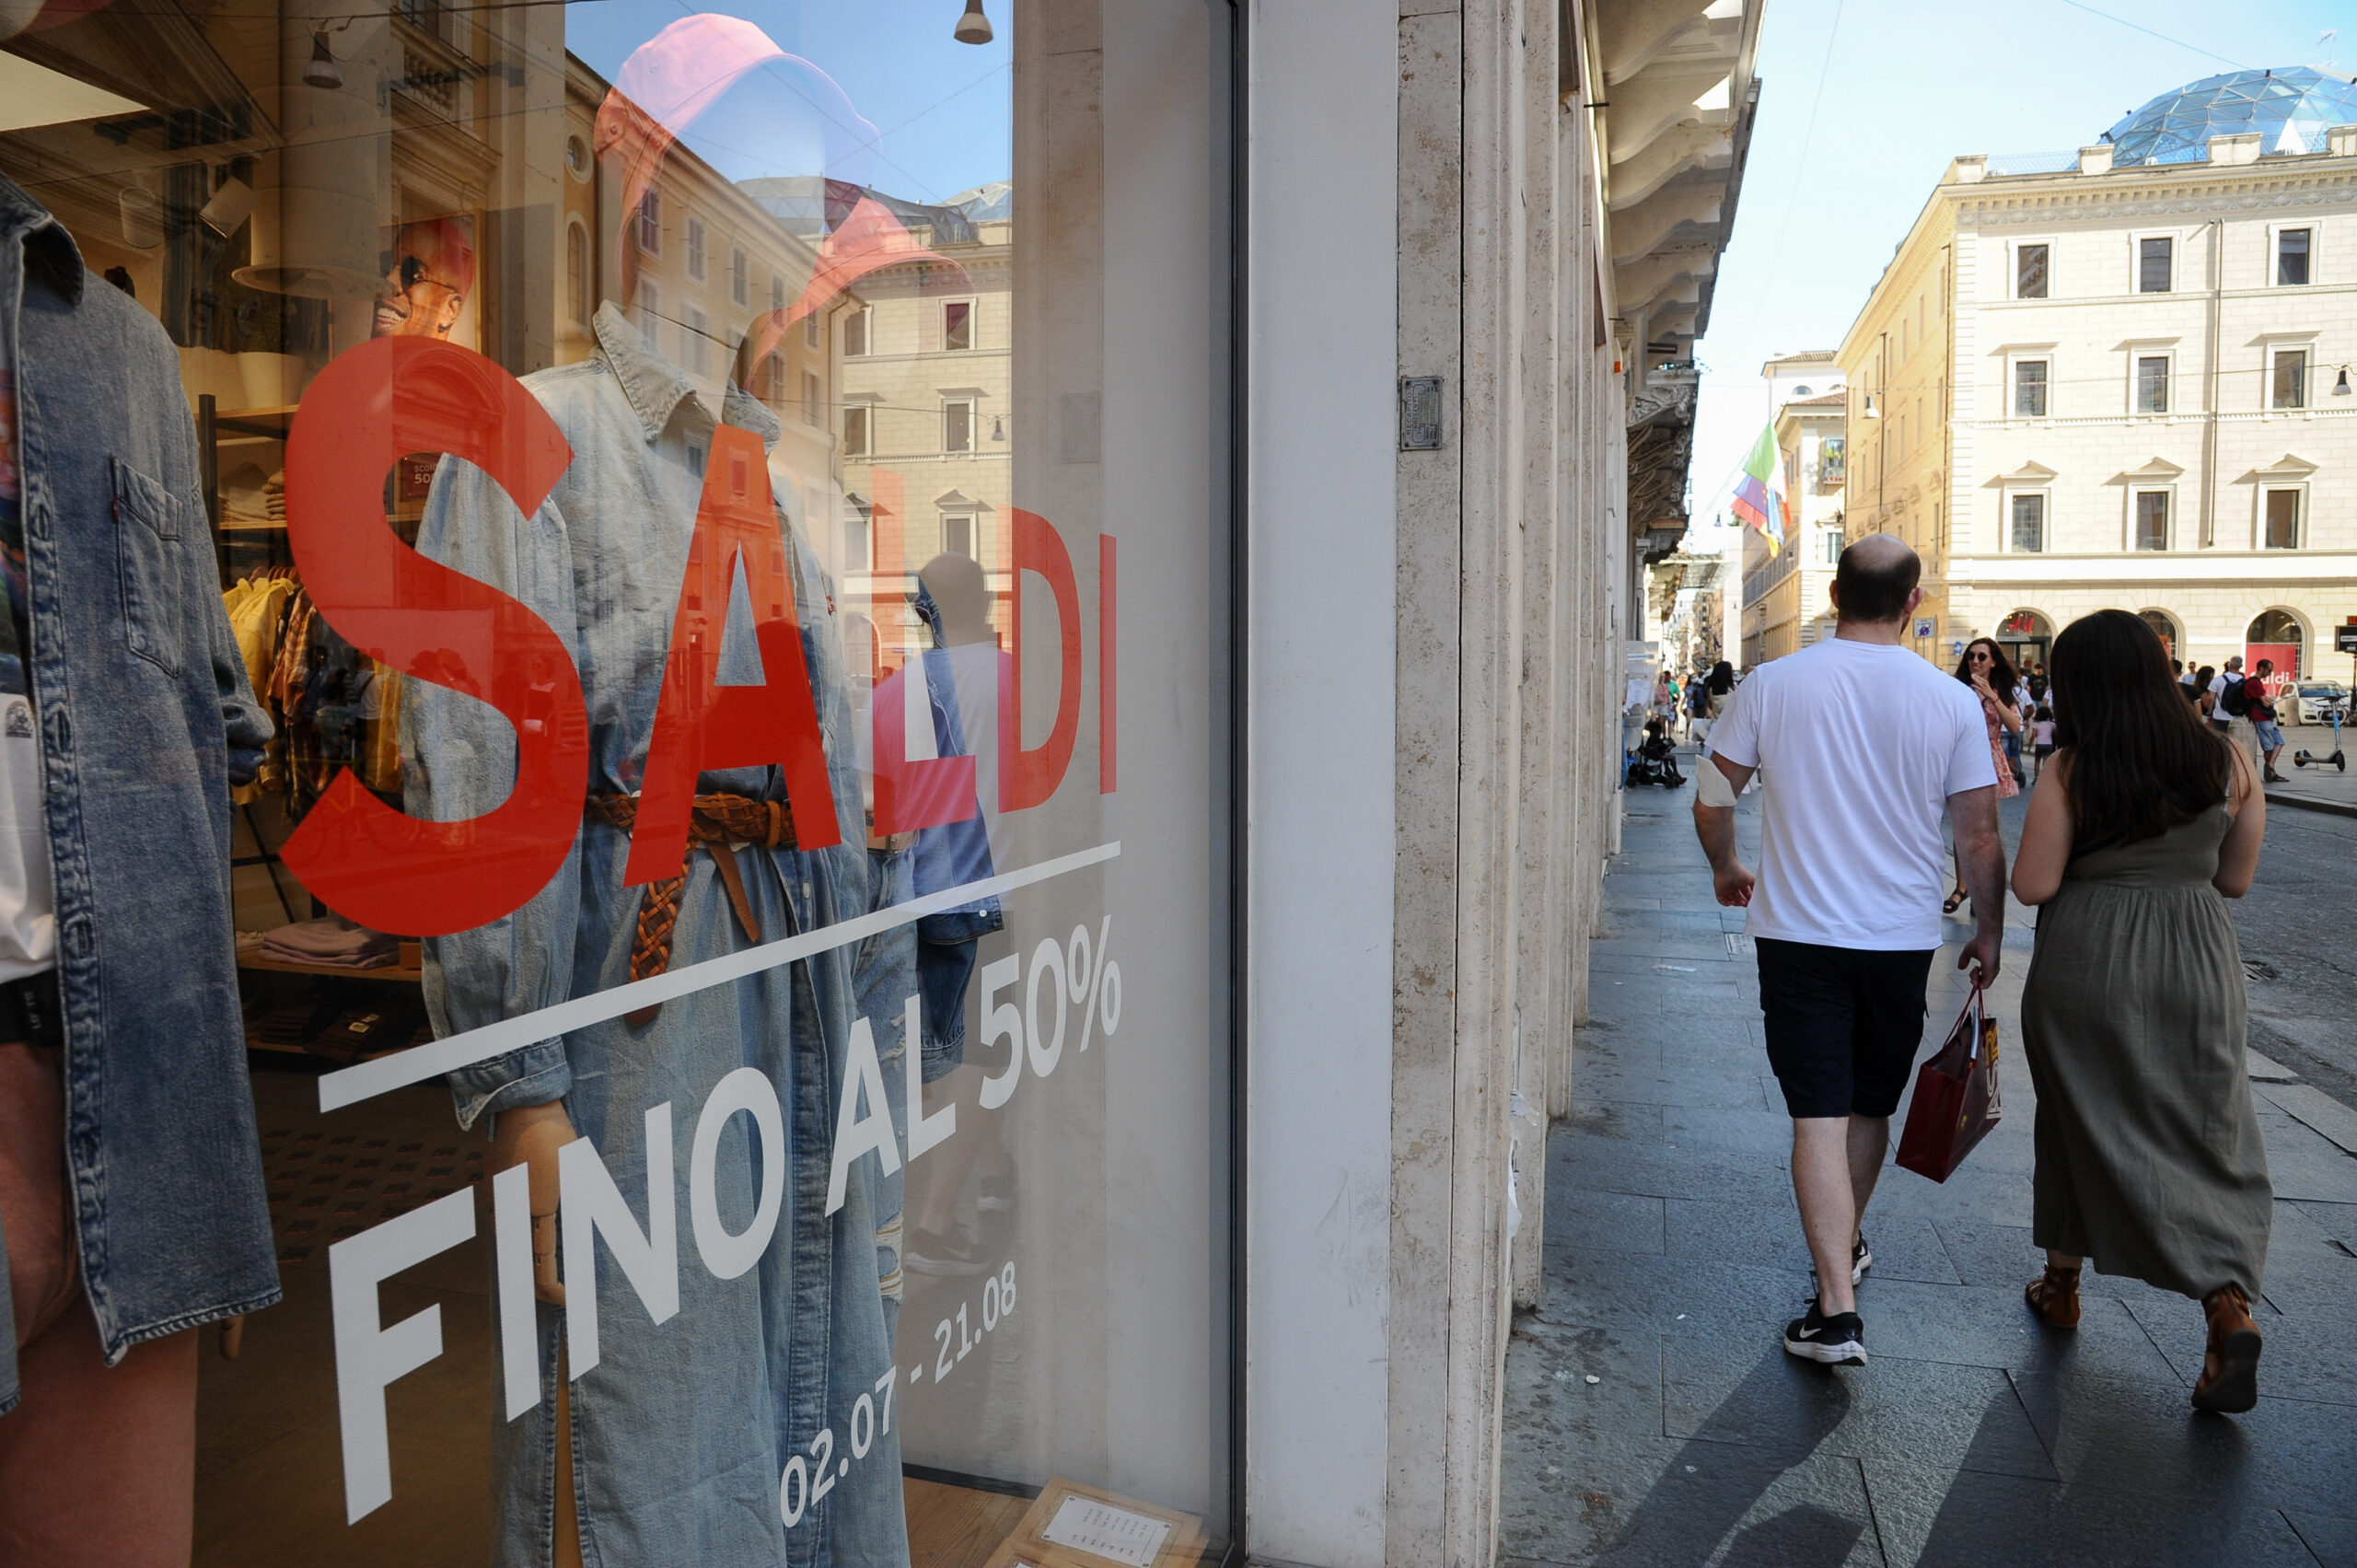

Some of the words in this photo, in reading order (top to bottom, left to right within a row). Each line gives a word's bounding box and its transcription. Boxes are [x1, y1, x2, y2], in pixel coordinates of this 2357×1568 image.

[279, 334, 1117, 936] SALDI
[328, 1067, 784, 1527] FINO
[825, 993, 956, 1217] AL
[979, 914, 1121, 1109] 50%
[780, 1365, 897, 1528] 02.07
[935, 1260, 1016, 1384] 21.08
